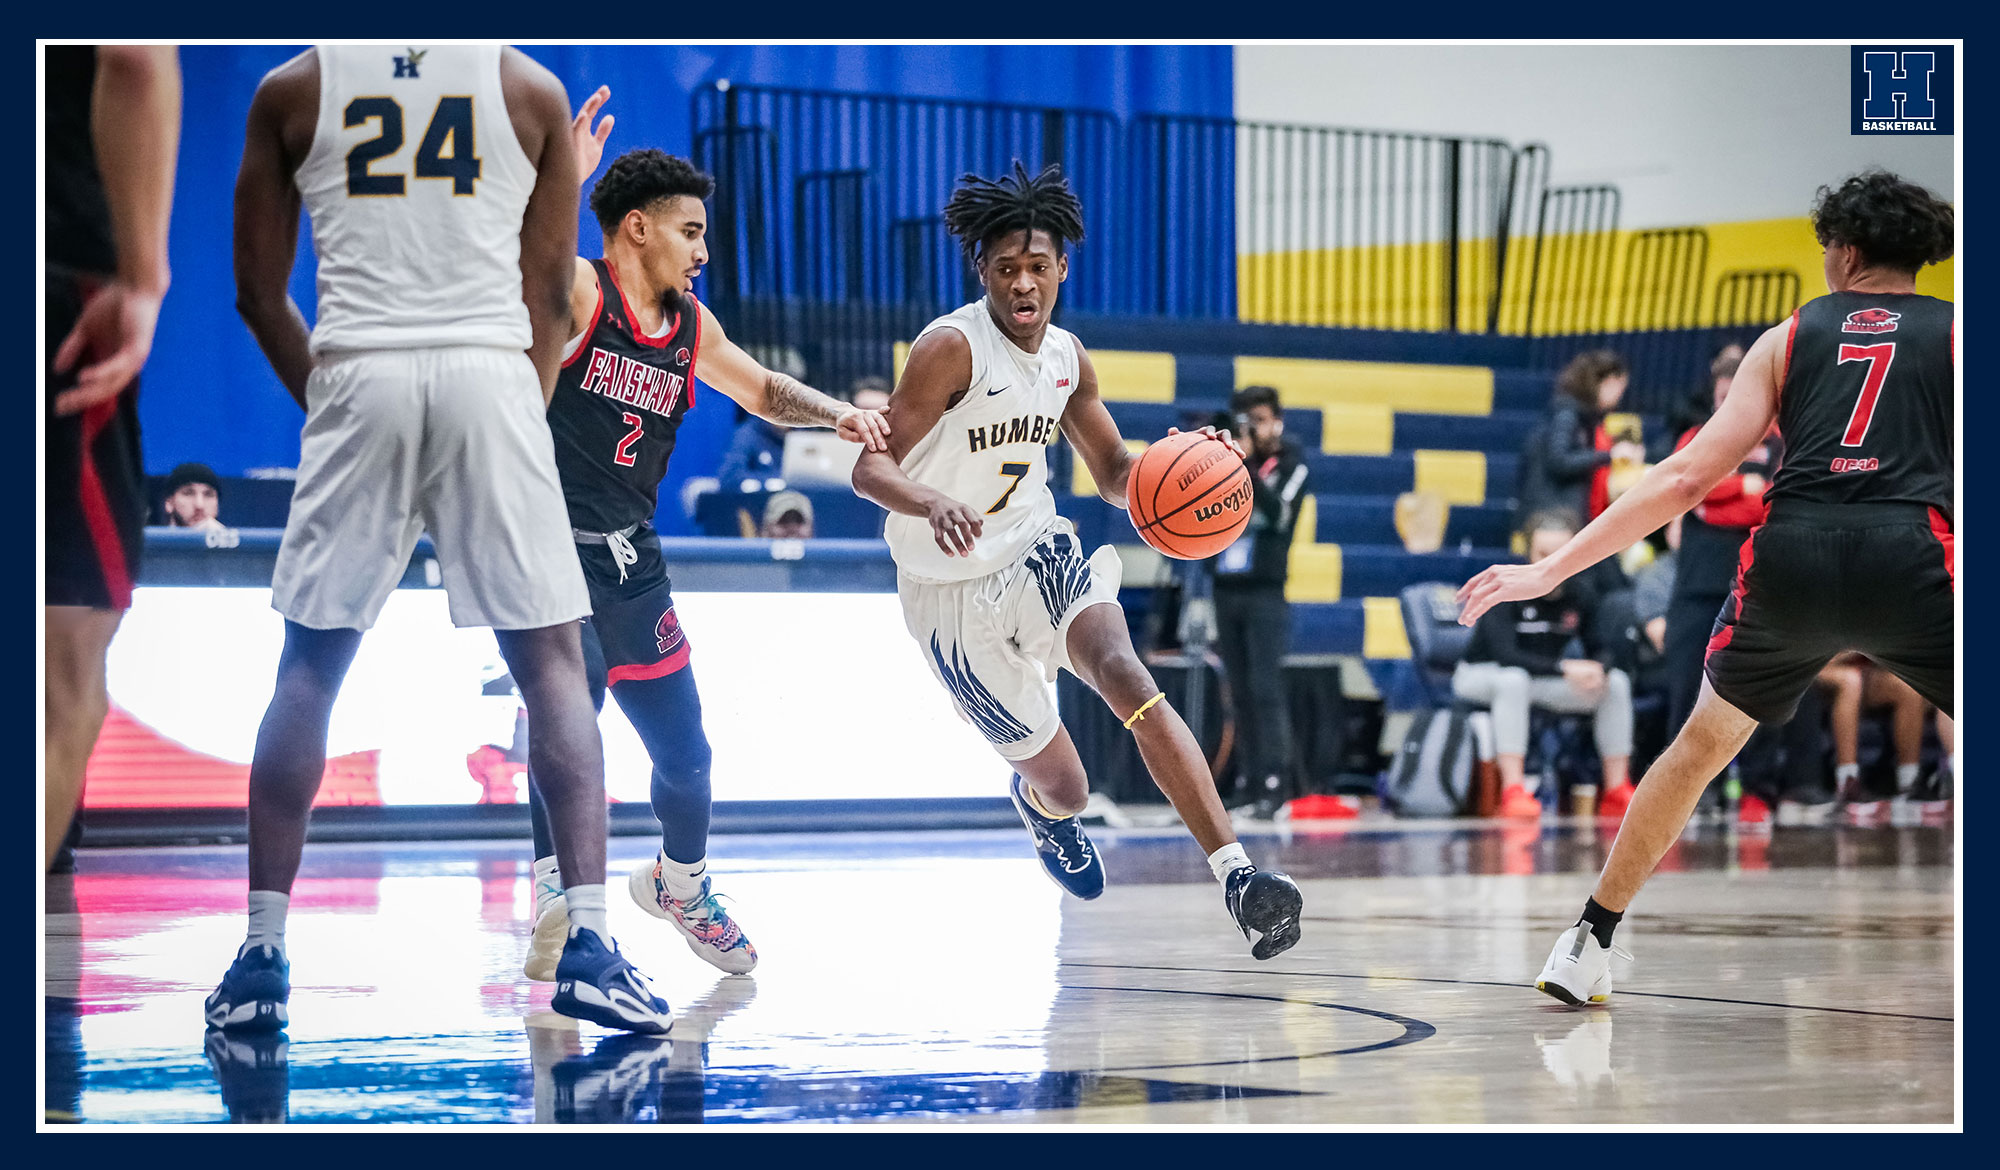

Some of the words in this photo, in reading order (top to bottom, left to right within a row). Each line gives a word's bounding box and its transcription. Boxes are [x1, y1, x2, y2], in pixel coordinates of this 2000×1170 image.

[392, 57, 420, 78] H
[343, 94, 483, 198] 24
[1837, 342, 1896, 447] 7
[613, 411, 645, 467] 2
[967, 414, 1055, 453] HUMBE
[984, 461, 1032, 515] 7
[1176, 447, 1234, 492] VOLUTION
[1193, 476, 1253, 522] Wilson
